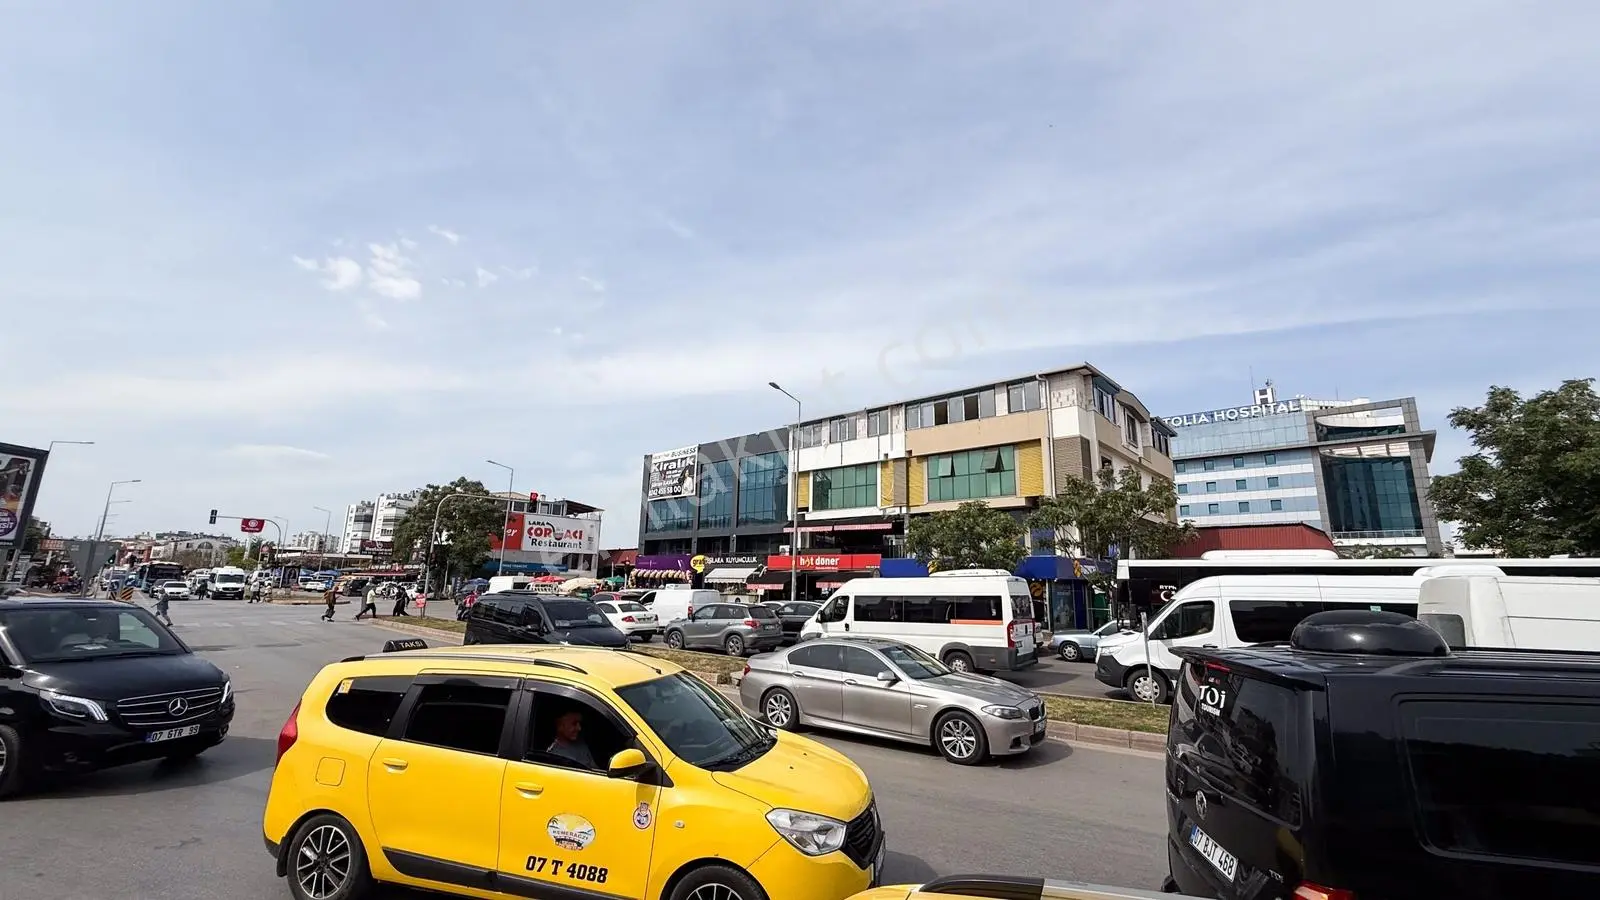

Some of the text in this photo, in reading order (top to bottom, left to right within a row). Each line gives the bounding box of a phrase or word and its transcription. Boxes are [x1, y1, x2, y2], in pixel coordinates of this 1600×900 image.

[1254, 388, 1274, 405] H
[1214, 401, 1300, 421] HOSPITAL
[673, 485, 681, 493] 00
[530, 538, 582, 549] Restaurant
[815, 555, 840, 566] döner
[1193, 829, 1235, 876] 07 BJT 468
[526, 855, 608, 884] 07 T 4088
